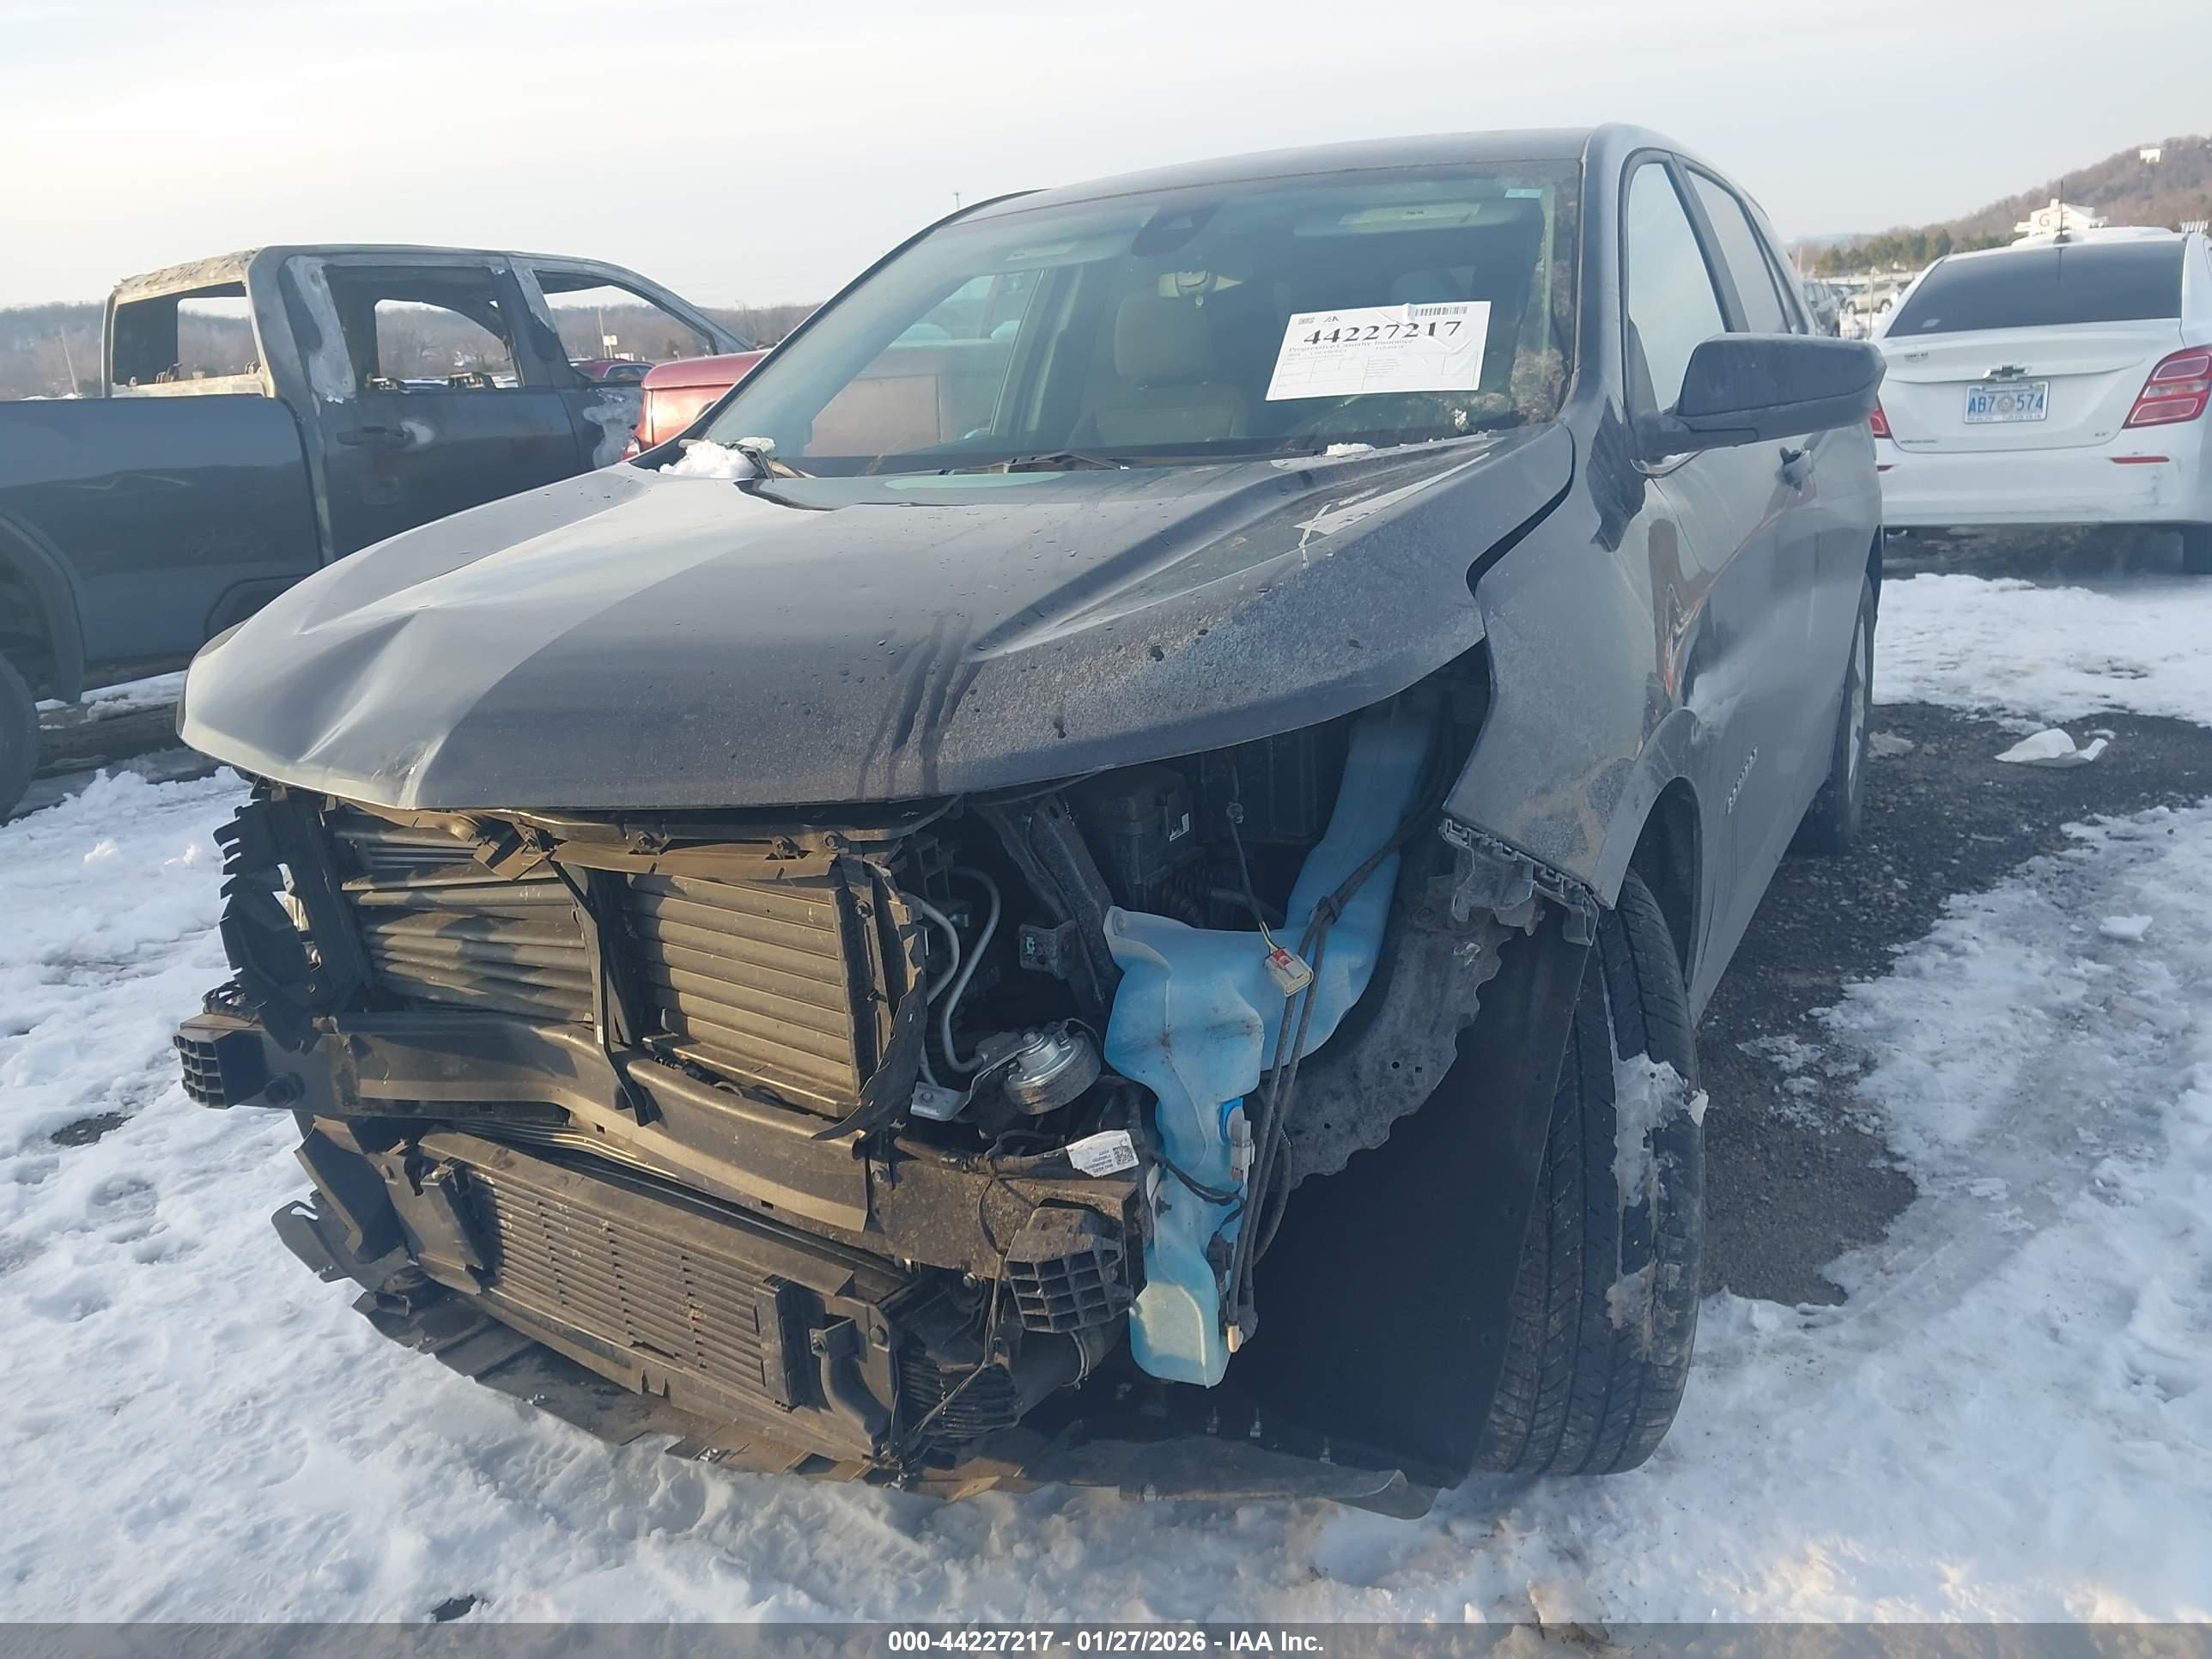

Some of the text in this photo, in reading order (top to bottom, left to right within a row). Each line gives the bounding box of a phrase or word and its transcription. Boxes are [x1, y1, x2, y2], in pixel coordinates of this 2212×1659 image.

[1304, 320, 1462, 344] 44227217
[1968, 393, 2044, 414] AB7 574
